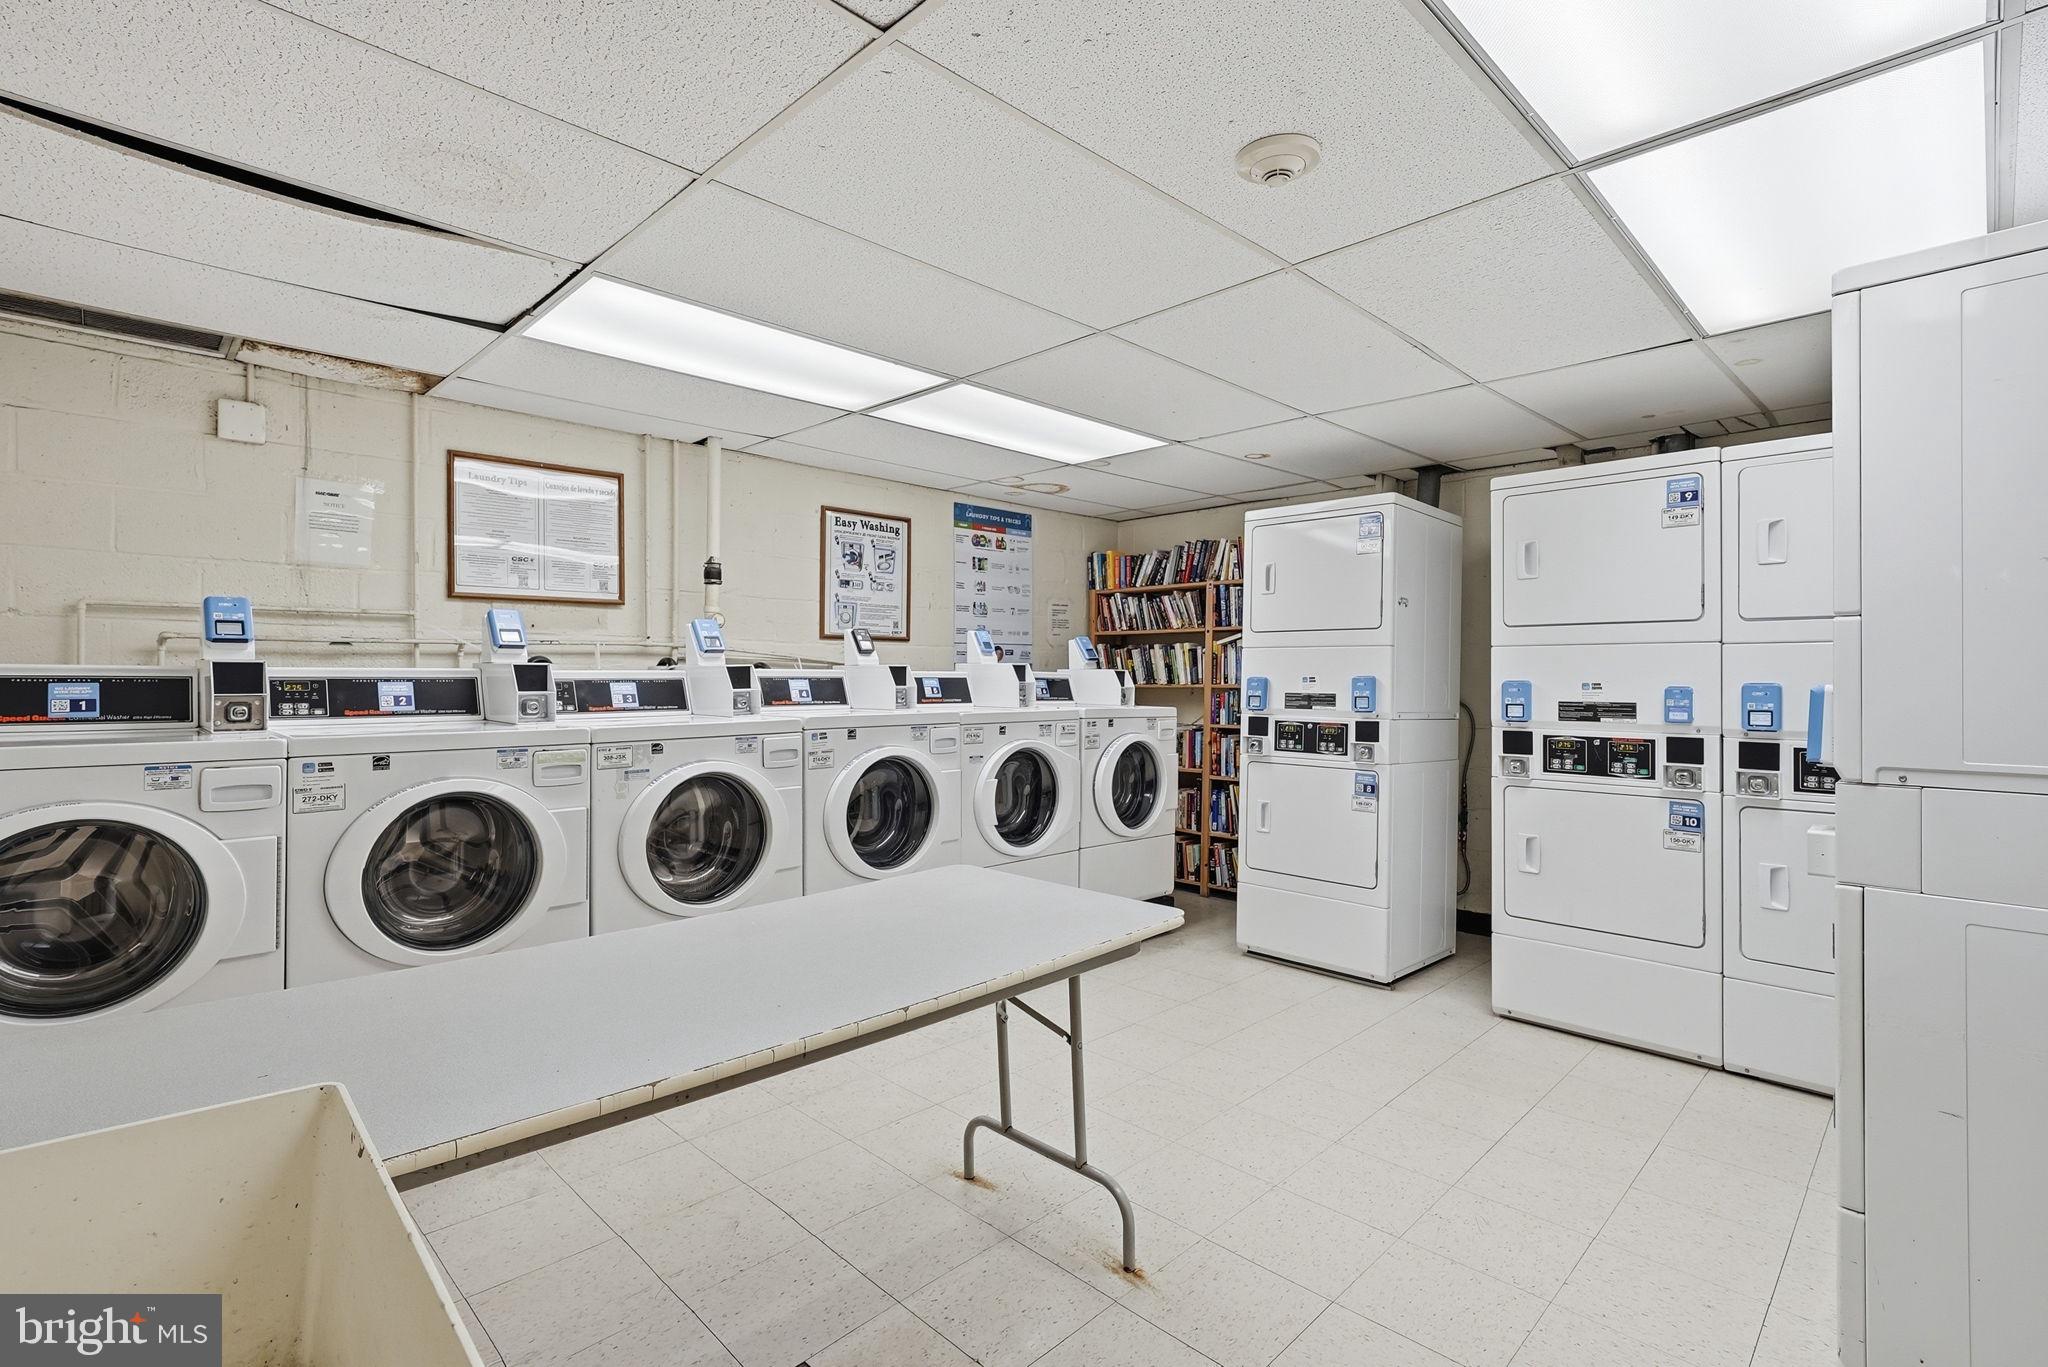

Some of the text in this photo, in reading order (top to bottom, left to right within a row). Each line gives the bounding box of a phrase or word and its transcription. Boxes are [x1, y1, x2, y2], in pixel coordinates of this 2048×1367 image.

[508, 476, 528, 488] Tips
[1684, 491, 1693, 501] 9
[834, 516, 901, 537] Easy Washing
[626, 695, 633, 703] 3
[801, 690, 807, 698] 4
[79, 700, 86, 711] 1
[399, 697, 407, 706] 2
[1366, 785, 1371, 793] 8
[1685, 817, 1697, 827] 10
